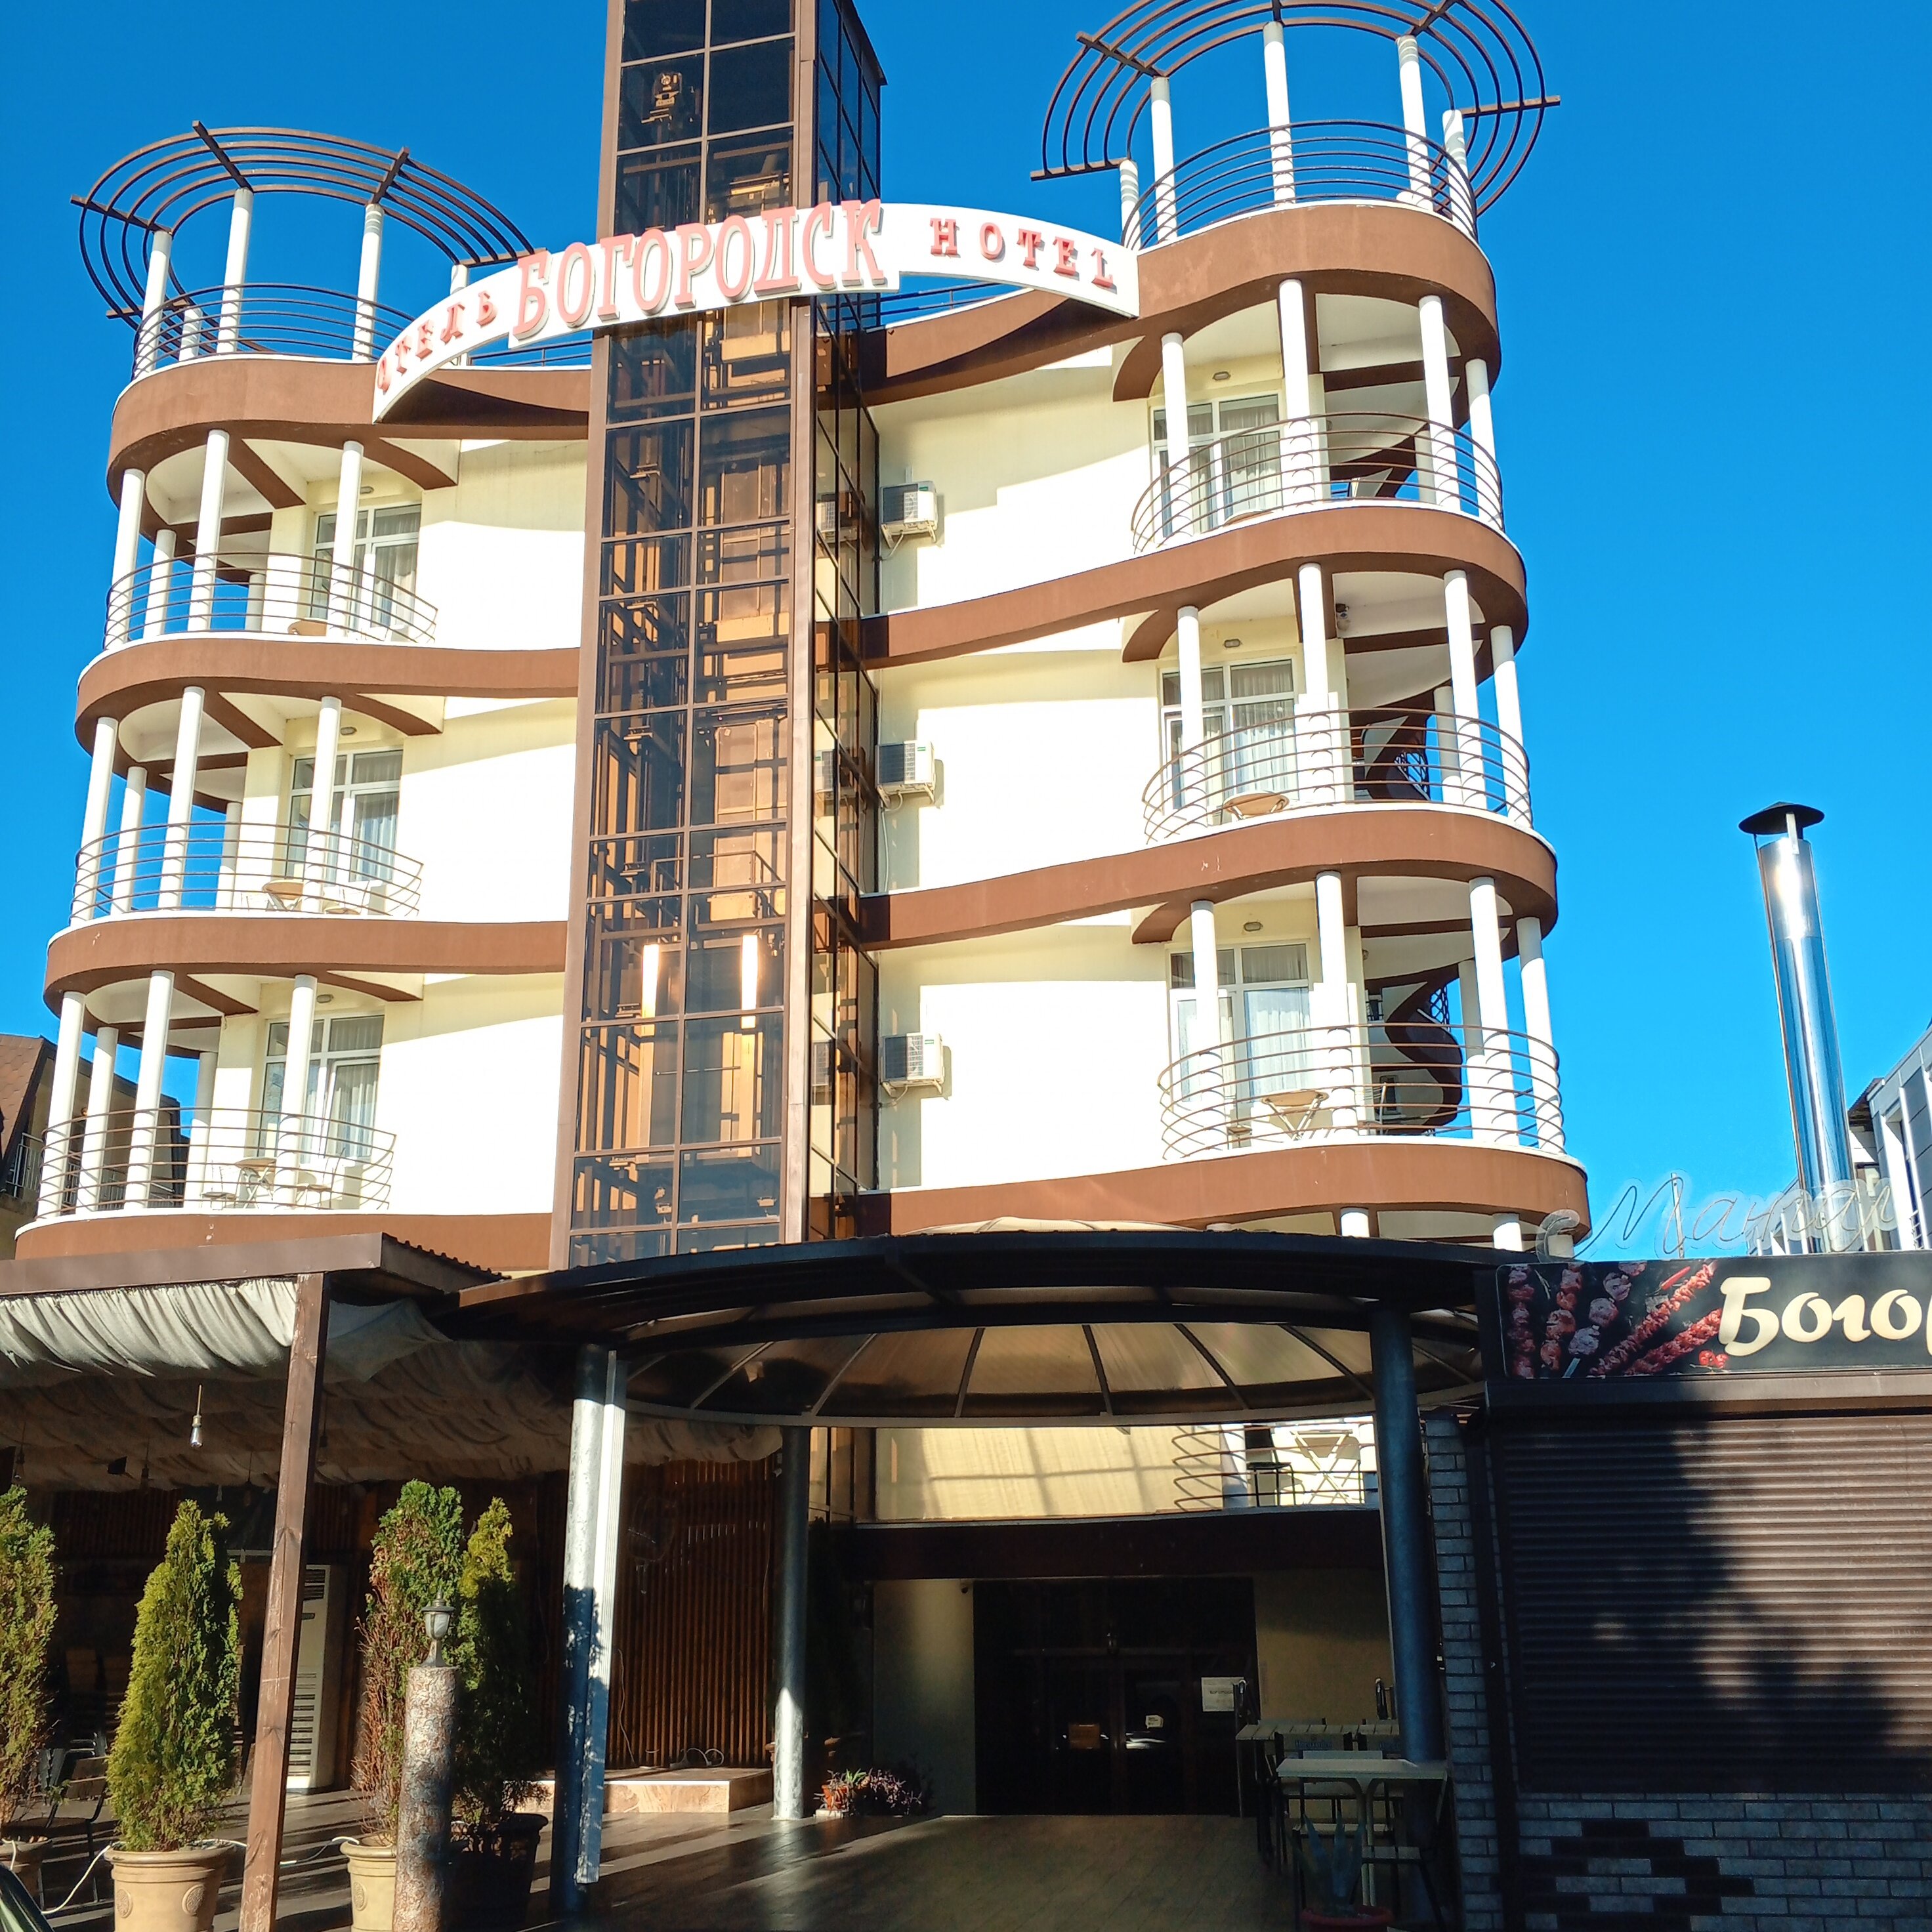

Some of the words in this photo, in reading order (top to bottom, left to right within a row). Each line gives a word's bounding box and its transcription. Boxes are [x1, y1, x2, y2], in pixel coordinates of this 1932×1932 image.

[377, 290, 498, 394] ОТЕЛЬ
[512, 199, 887, 341] БОГОРОДСК
[929, 217, 1116, 289] HOTEL
[1718, 1276, 1932, 1356] Бого
